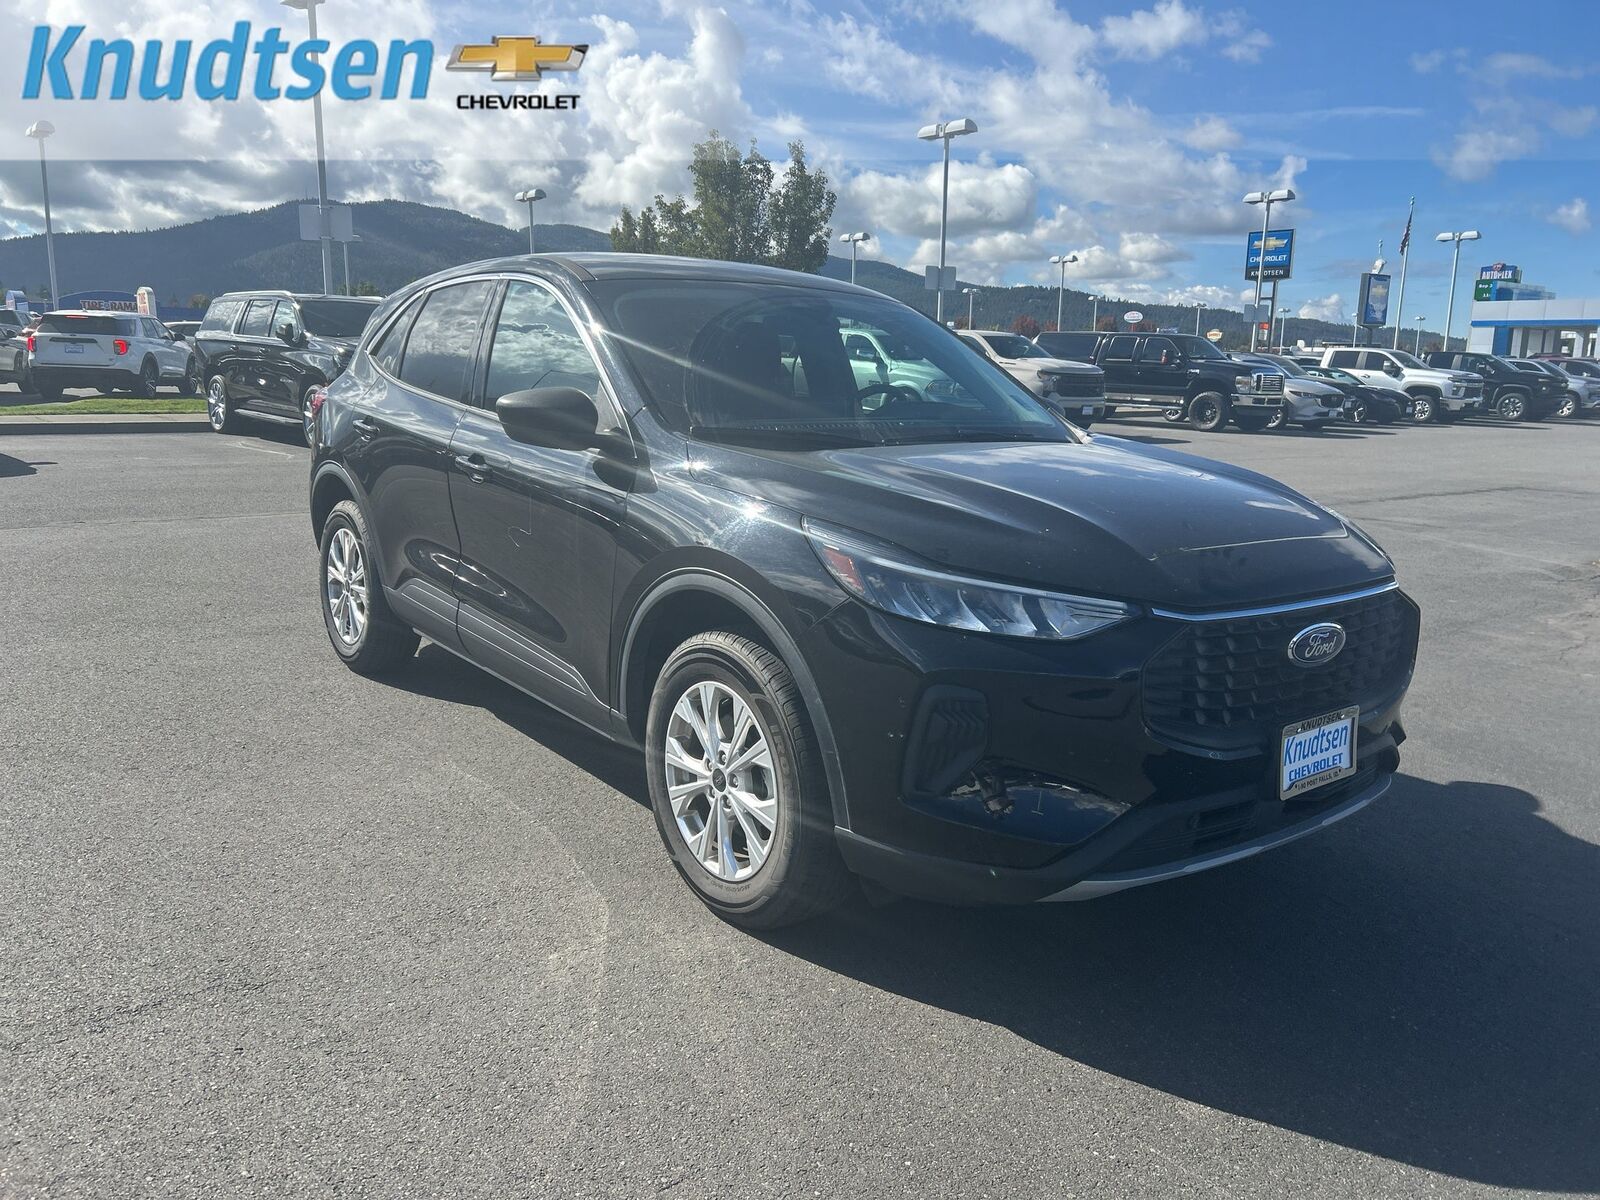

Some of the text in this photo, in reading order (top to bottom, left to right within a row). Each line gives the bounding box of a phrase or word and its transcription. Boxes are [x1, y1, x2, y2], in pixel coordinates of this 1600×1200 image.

[1482, 270, 1512, 280] AUTOPLEX
[1304, 632, 1337, 658] Ford
[1300, 711, 1342, 731] KNUDTSEN
[1283, 725, 1349, 766] Knudtsen
[1288, 752, 1344, 782] CHEVROLET
[1306, 778, 1318, 787] POST
